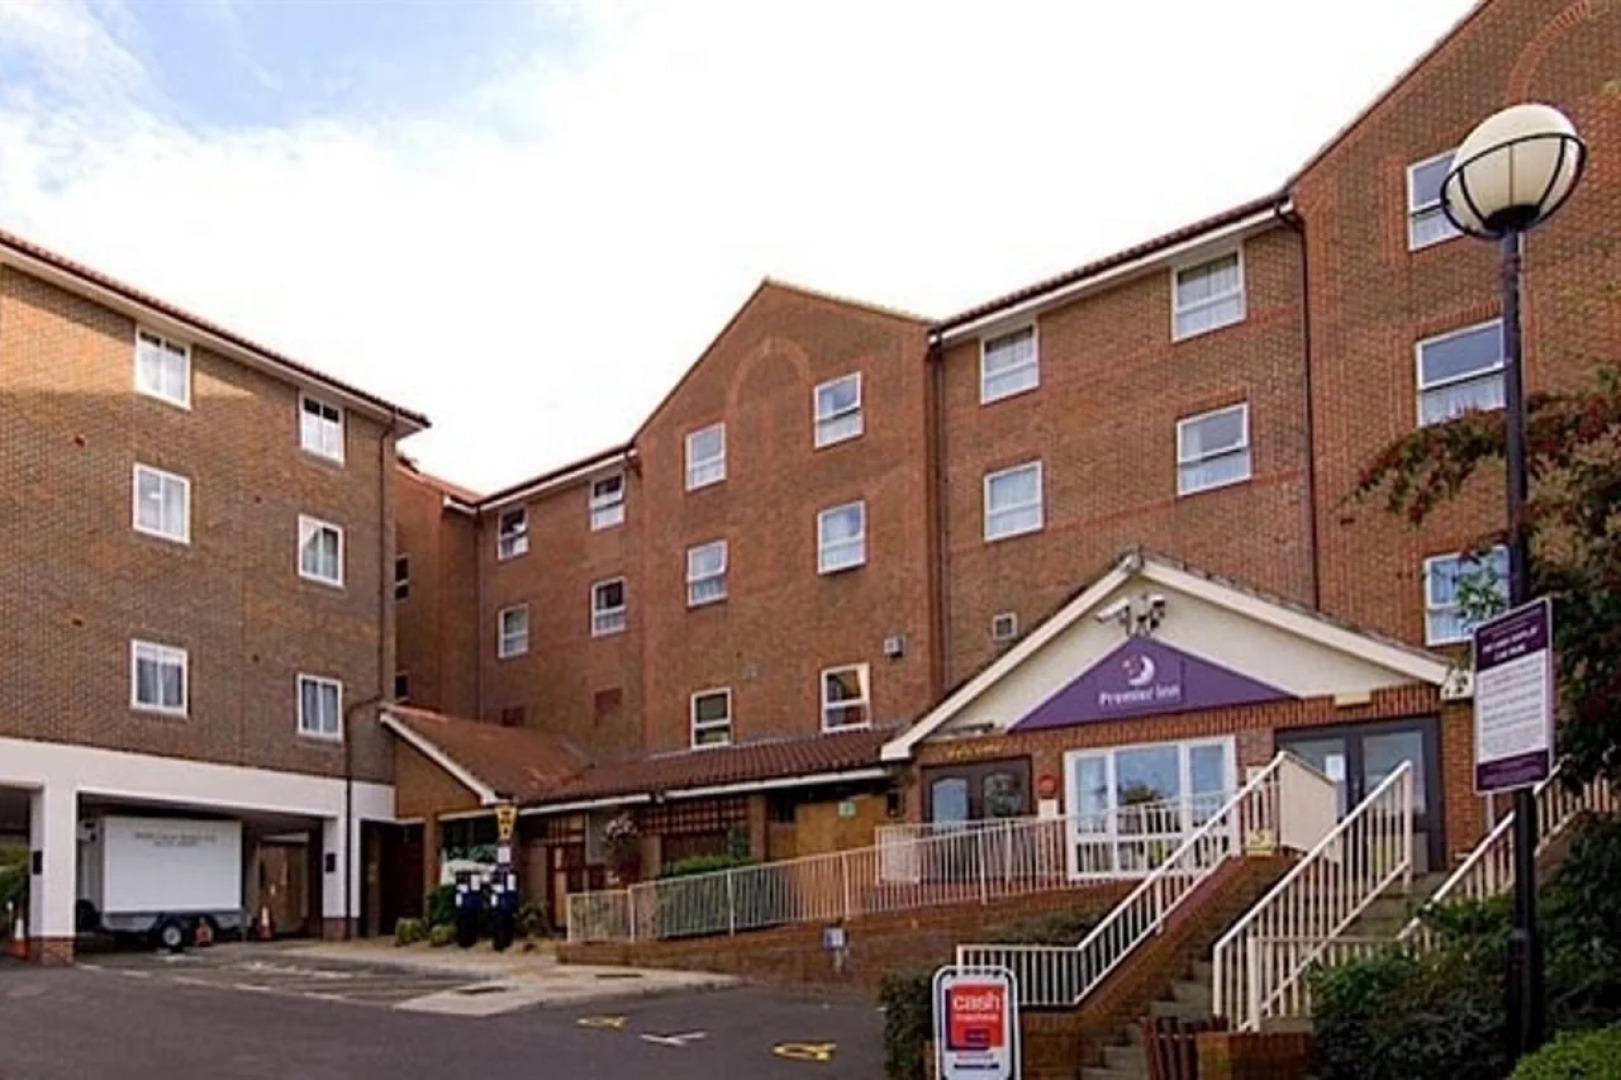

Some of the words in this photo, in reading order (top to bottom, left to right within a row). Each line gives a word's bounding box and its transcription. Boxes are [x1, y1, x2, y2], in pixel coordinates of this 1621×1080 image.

[1099, 686, 1153, 705] Premier
[1156, 682, 1180, 699] Inn
[953, 990, 1000, 1011] cash
